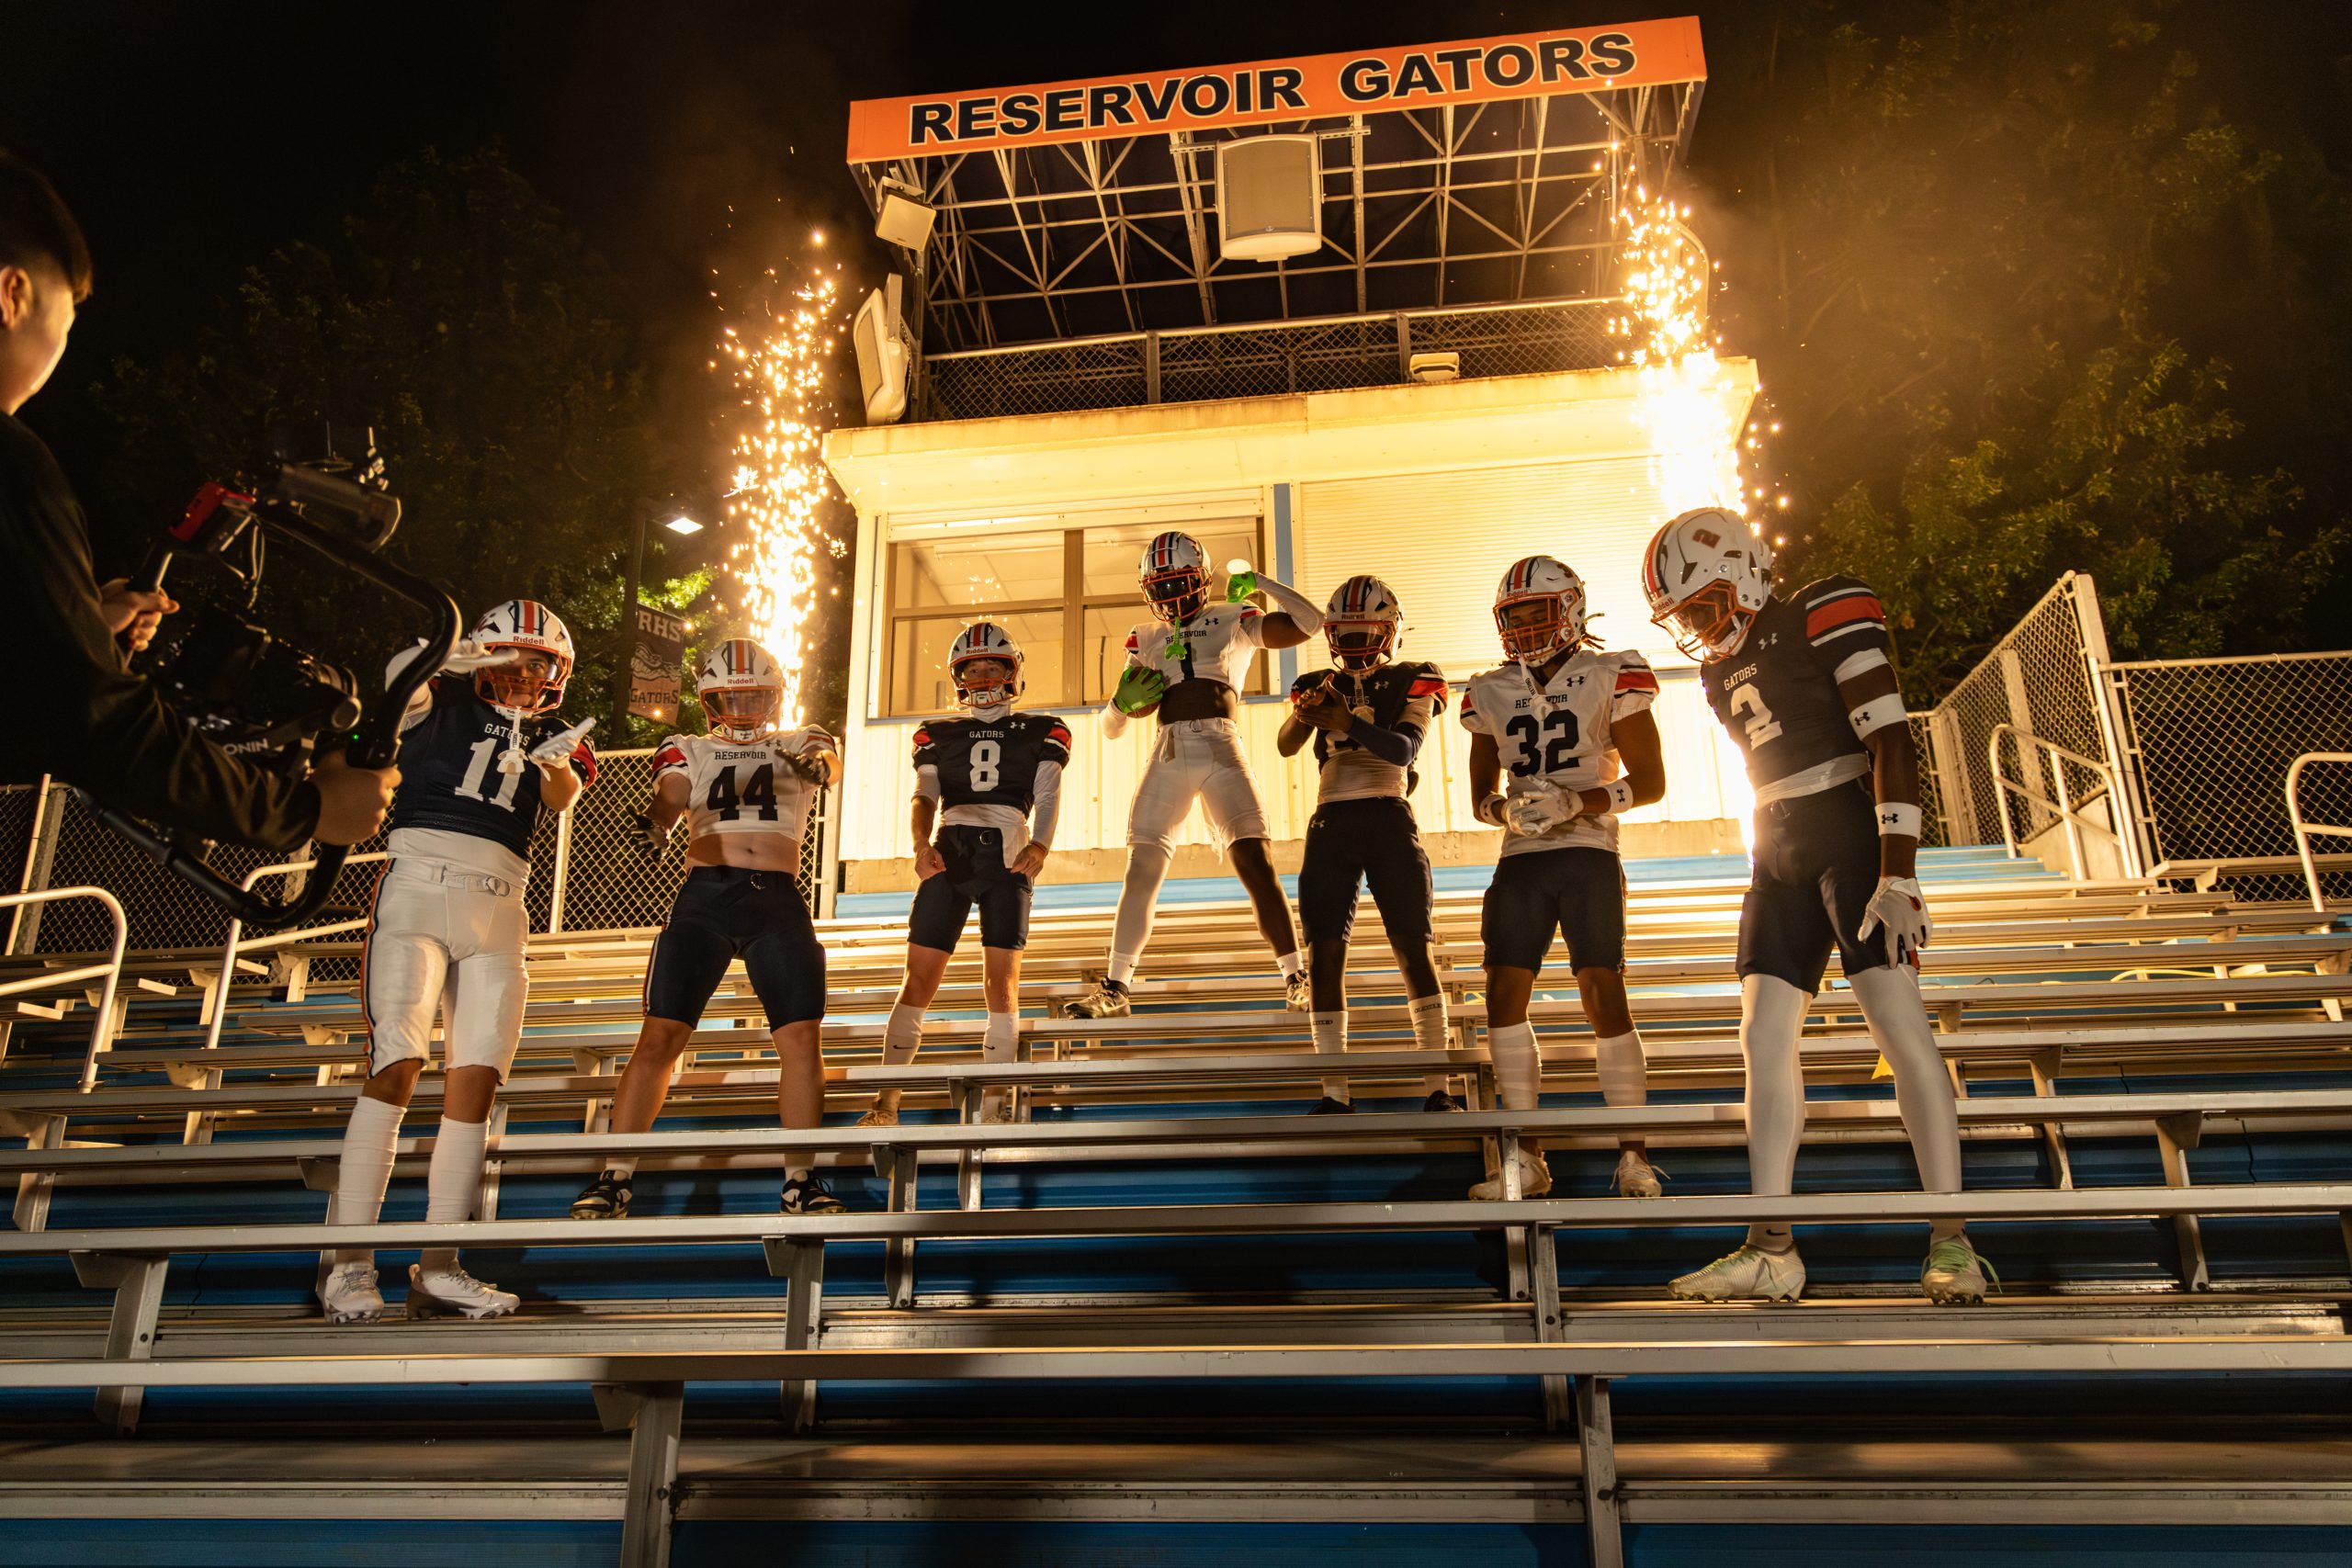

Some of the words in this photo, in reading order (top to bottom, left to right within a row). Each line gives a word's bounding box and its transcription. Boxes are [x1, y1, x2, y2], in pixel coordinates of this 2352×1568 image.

[910, 68, 1311, 145] RESERVOIR
[1339, 32, 1637, 103] GATORS
[514, 636, 545, 645] Riddell
[638, 610, 681, 643] RHS
[1724, 663, 1758, 691] GATORS
[630, 688, 679, 705] GATORS
[1730, 682, 1783, 750] 2
[221, 738, 269, 755] ONIN
[969, 730, 1005, 739] GATORS
[1506, 709, 1580, 777] 32
[714, 750, 767, 761] RESERVOIR
[969, 739, 1001, 793] 8
[707, 763, 779, 821] 44
